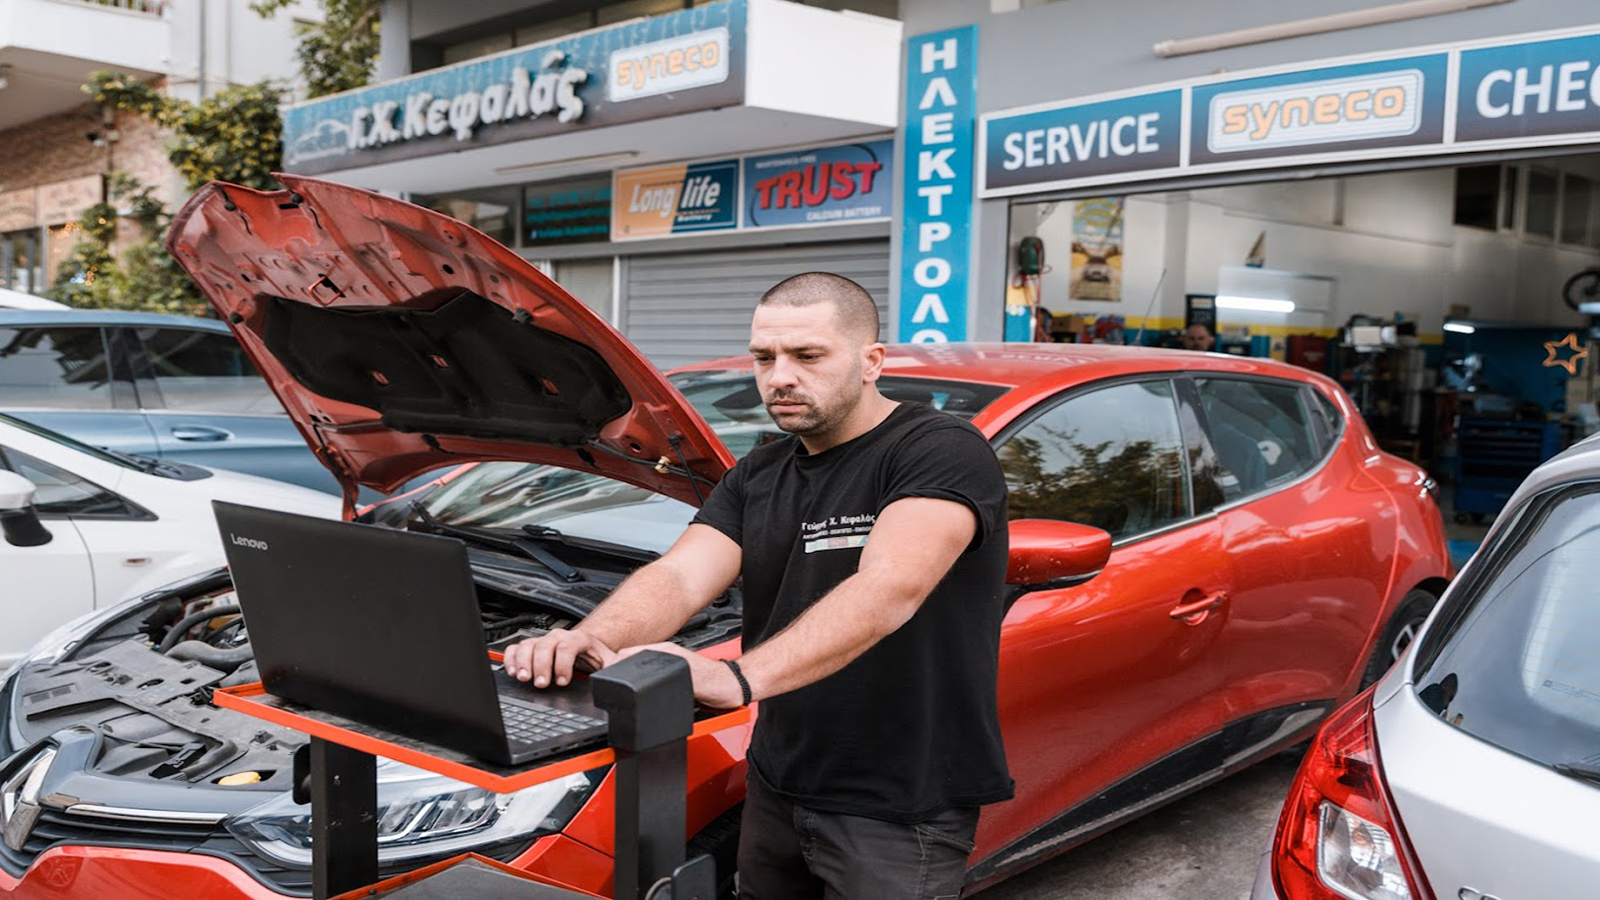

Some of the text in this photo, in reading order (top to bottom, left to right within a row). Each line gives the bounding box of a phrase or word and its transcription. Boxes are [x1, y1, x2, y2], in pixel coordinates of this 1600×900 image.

[617, 41, 719, 90] syneco
[1476, 60, 1600, 118] CHE
[1222, 86, 1406, 141] syneco
[1002, 111, 1160, 170] SERVICE
[629, 184, 678, 219] Long
[680, 175, 721, 208] life
[754, 159, 882, 209] TRUST
[230, 532, 268, 551] Lenovo
